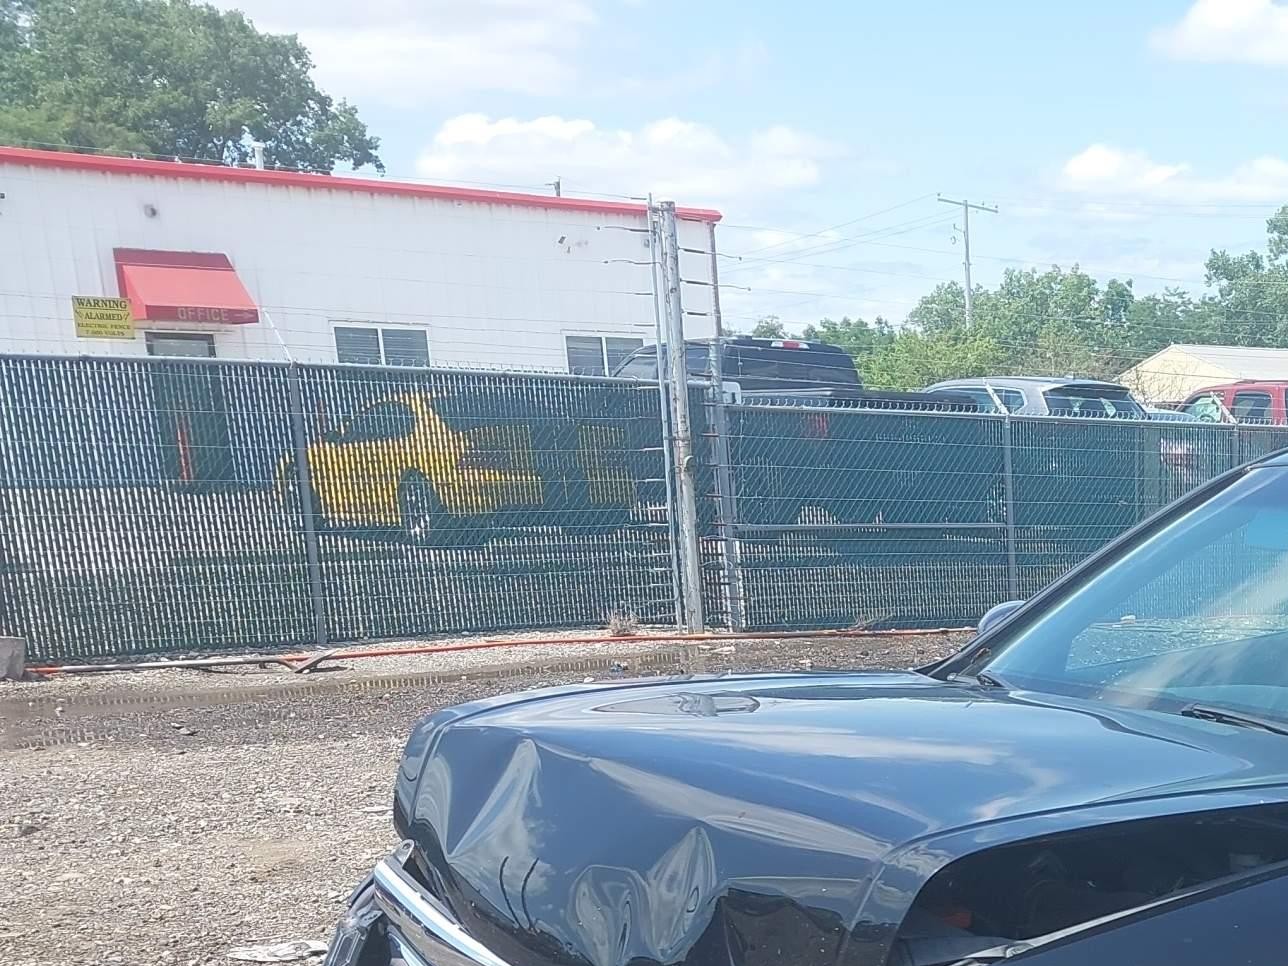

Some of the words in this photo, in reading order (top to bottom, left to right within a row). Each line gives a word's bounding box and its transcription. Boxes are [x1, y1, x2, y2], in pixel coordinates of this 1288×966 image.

[76, 298, 127, 309] WARNING
[84, 312, 122, 321] ALARMED
[177, 307, 229, 321] OFFICE
